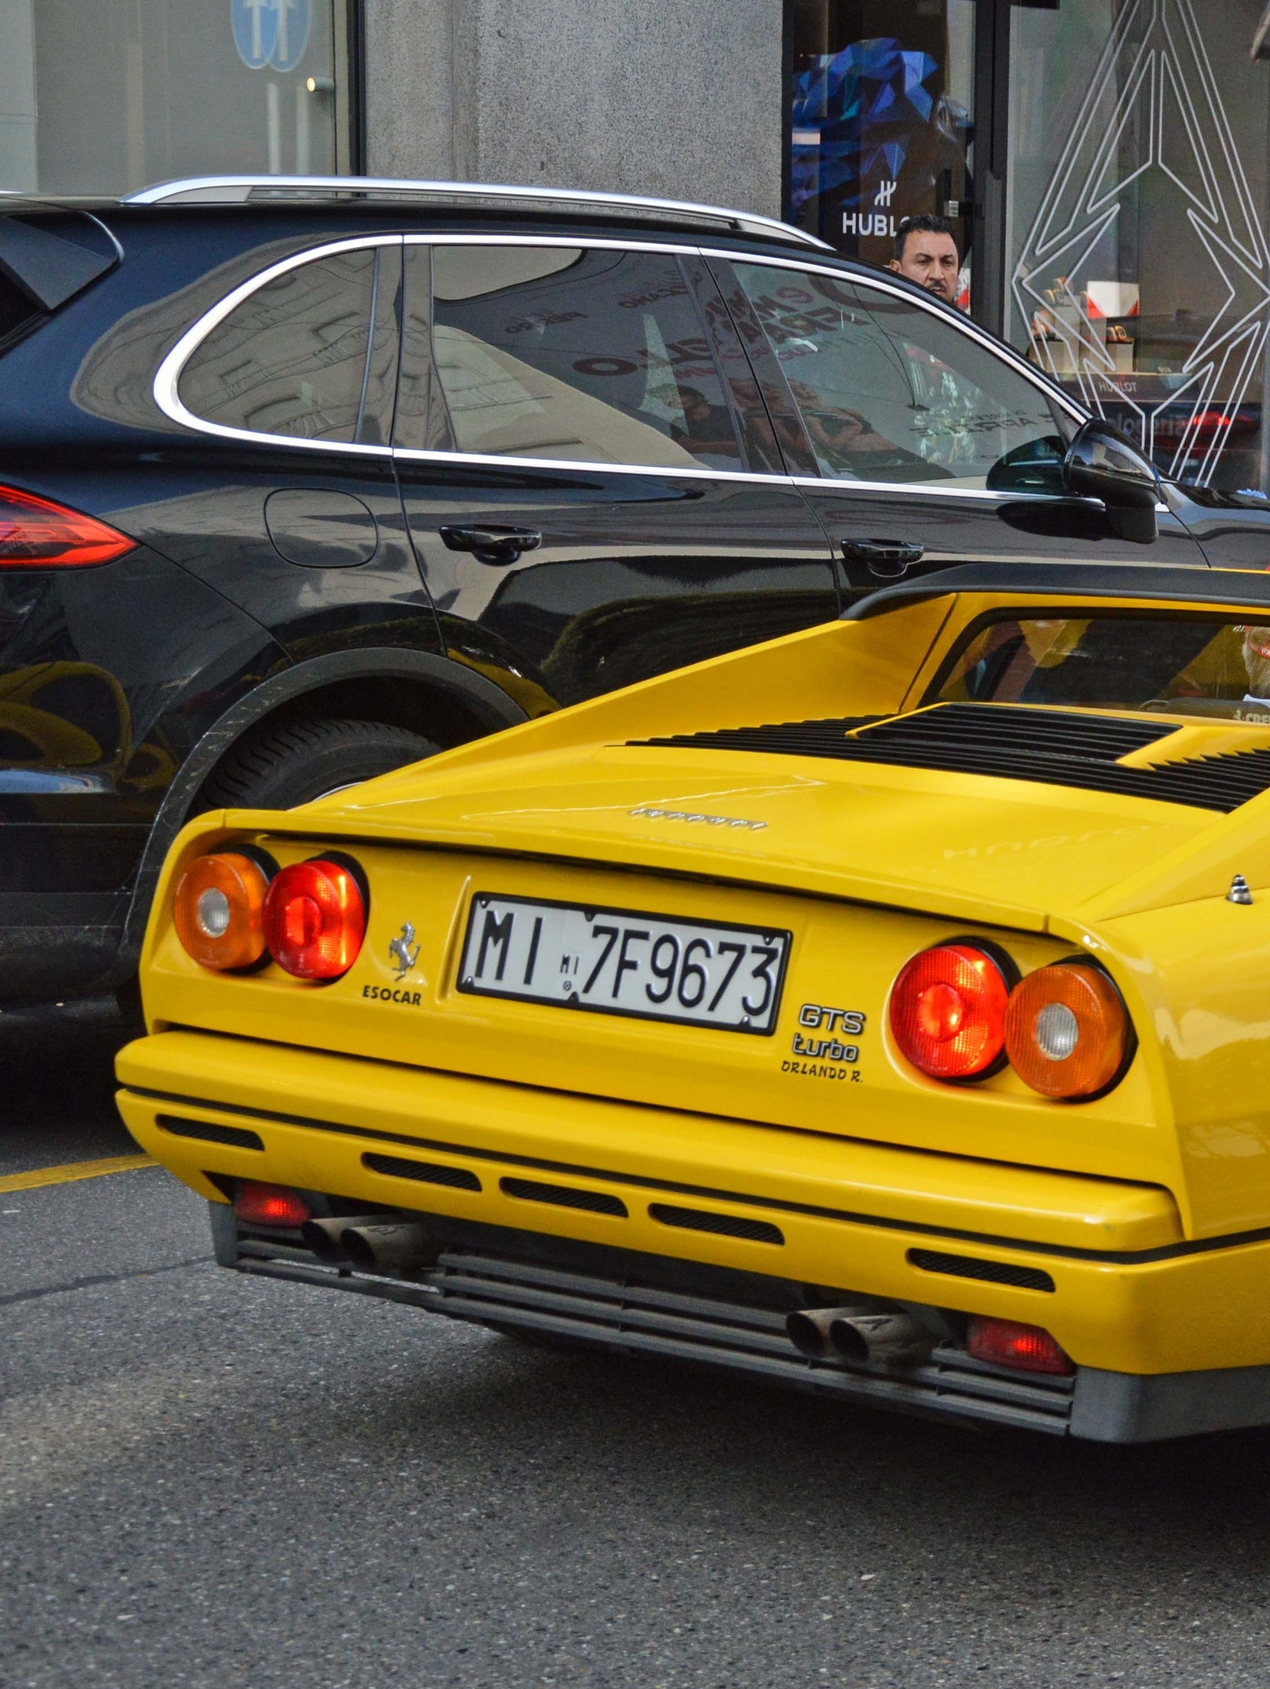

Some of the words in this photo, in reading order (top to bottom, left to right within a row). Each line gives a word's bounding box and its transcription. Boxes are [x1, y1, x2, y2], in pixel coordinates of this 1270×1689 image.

[842, 211, 910, 237] HUBL
[475, 910, 544, 985] MI
[582, 925, 780, 1017] 7F9673
[362, 984, 422, 1006] ESOCAR
[799, 1003, 867, 1036] GTS
[792, 1032, 860, 1064] turbo
[781, 1060, 847, 1080] ORLANDO
[850, 1070, 864, 1083] R.
